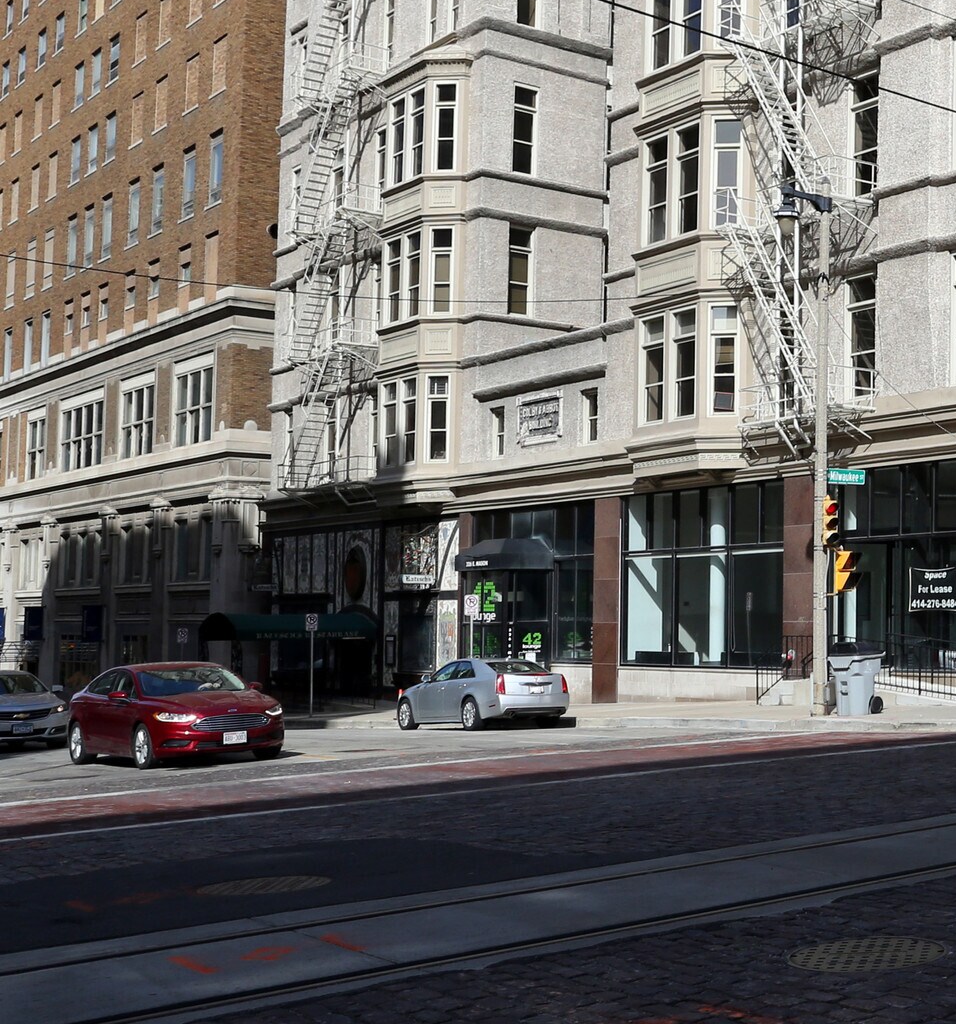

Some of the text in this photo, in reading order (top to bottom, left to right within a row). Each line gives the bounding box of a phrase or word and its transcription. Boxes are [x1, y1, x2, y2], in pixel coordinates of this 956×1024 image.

[830, 470, 859, 482] Milwaukee
[924, 571, 947, 581] Space
[918, 584, 953, 594] For Lease
[522, 632, 542, 645] 42
